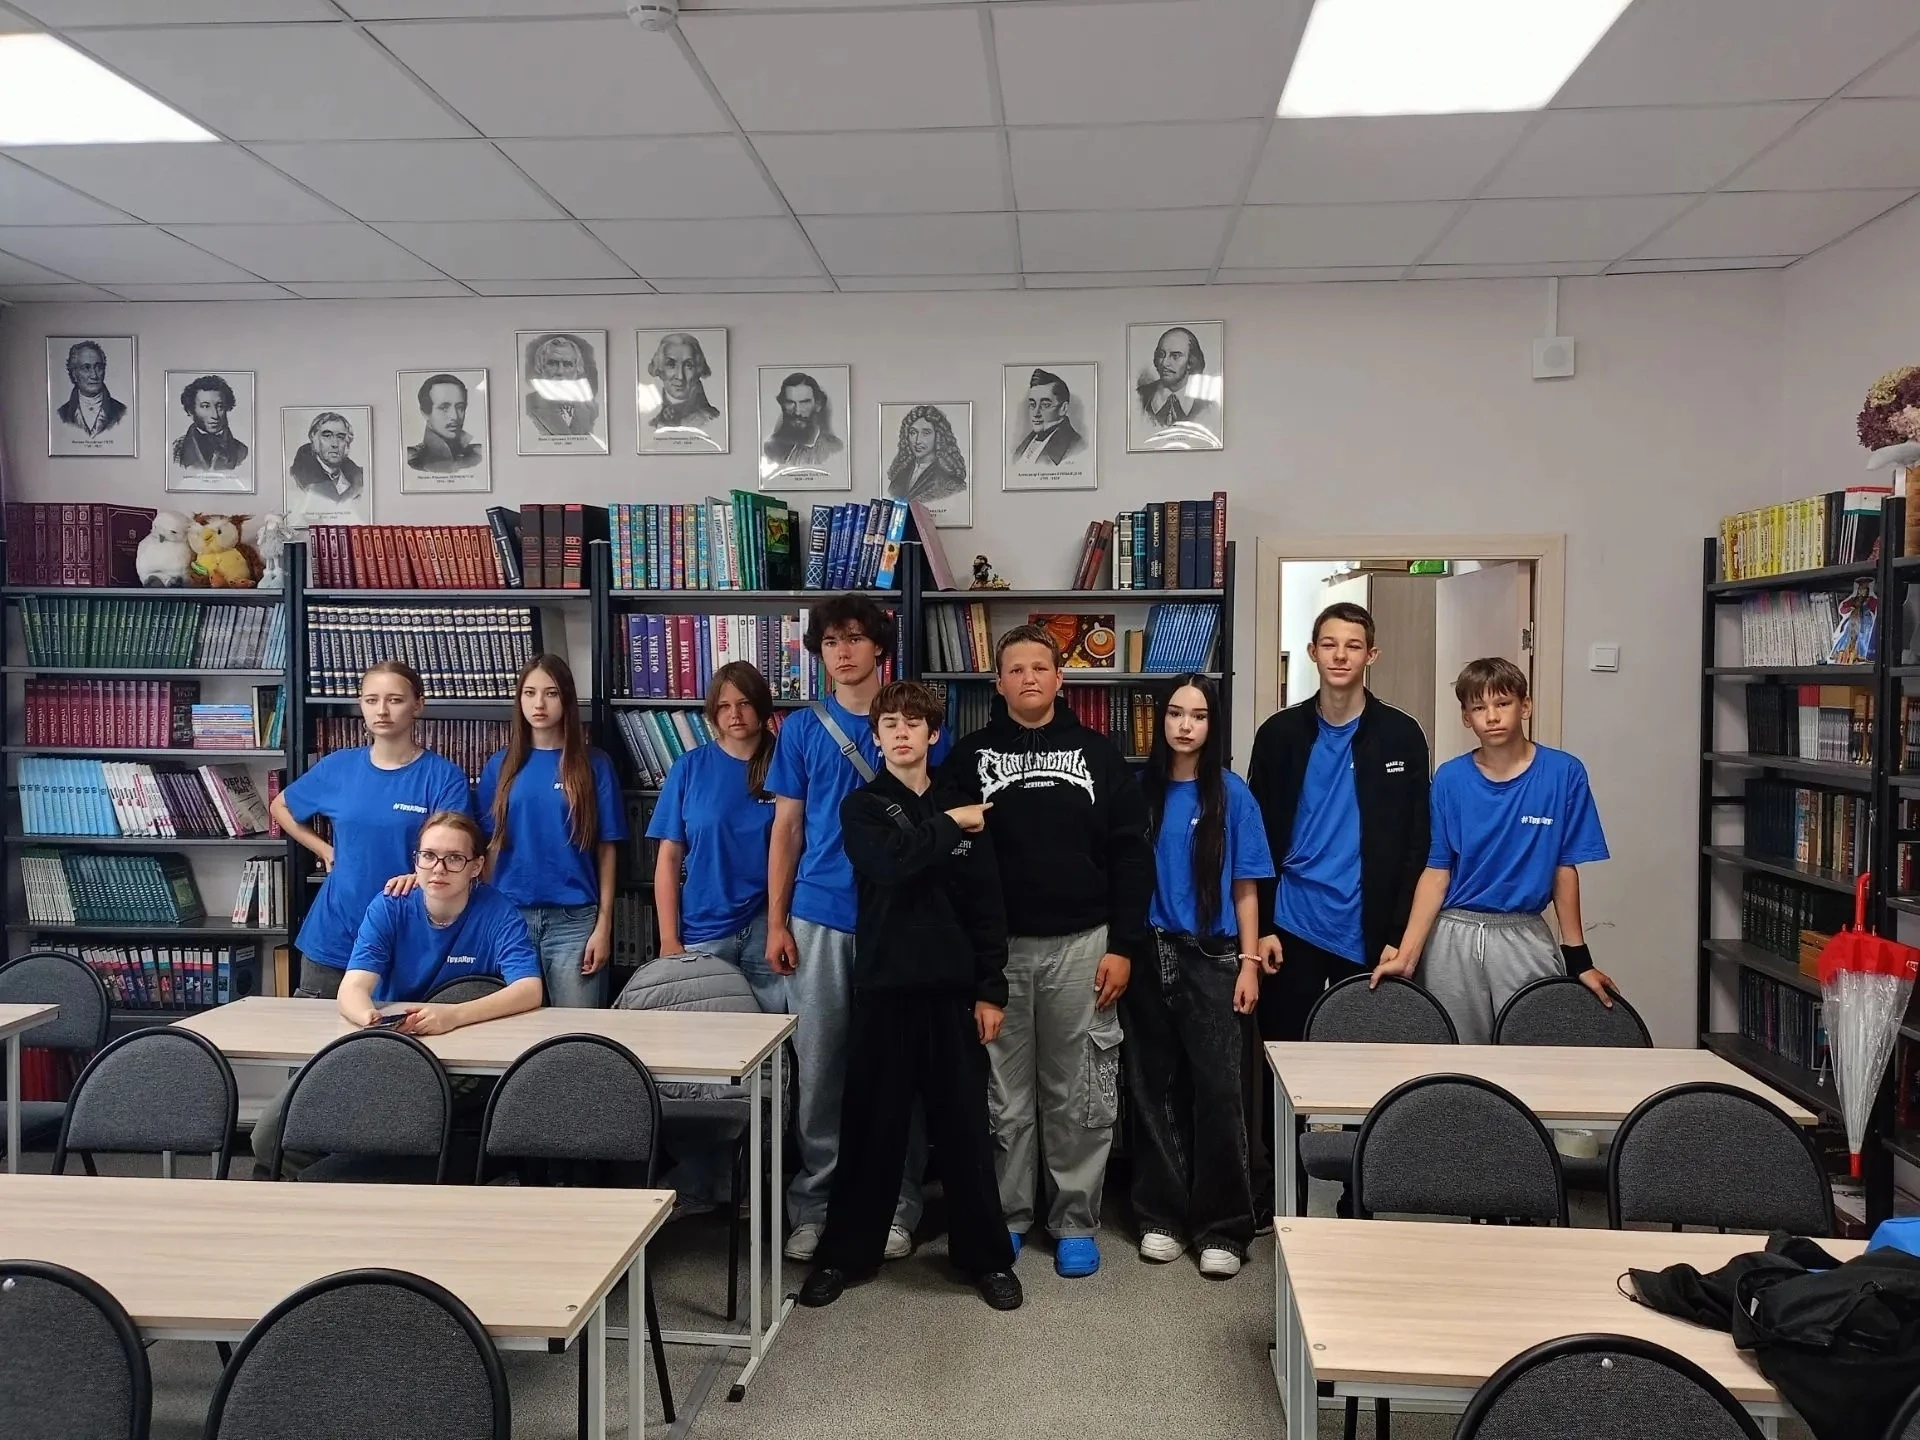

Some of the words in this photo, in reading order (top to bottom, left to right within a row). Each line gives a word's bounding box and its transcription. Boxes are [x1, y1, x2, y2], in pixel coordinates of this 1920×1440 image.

[633, 634, 642, 672] ФИЗИКА
[718, 618, 728, 652] ФИЗИКА
[650, 635, 659, 673] ФИЗИКА
[681, 640, 690, 673] ХИМИЯ
